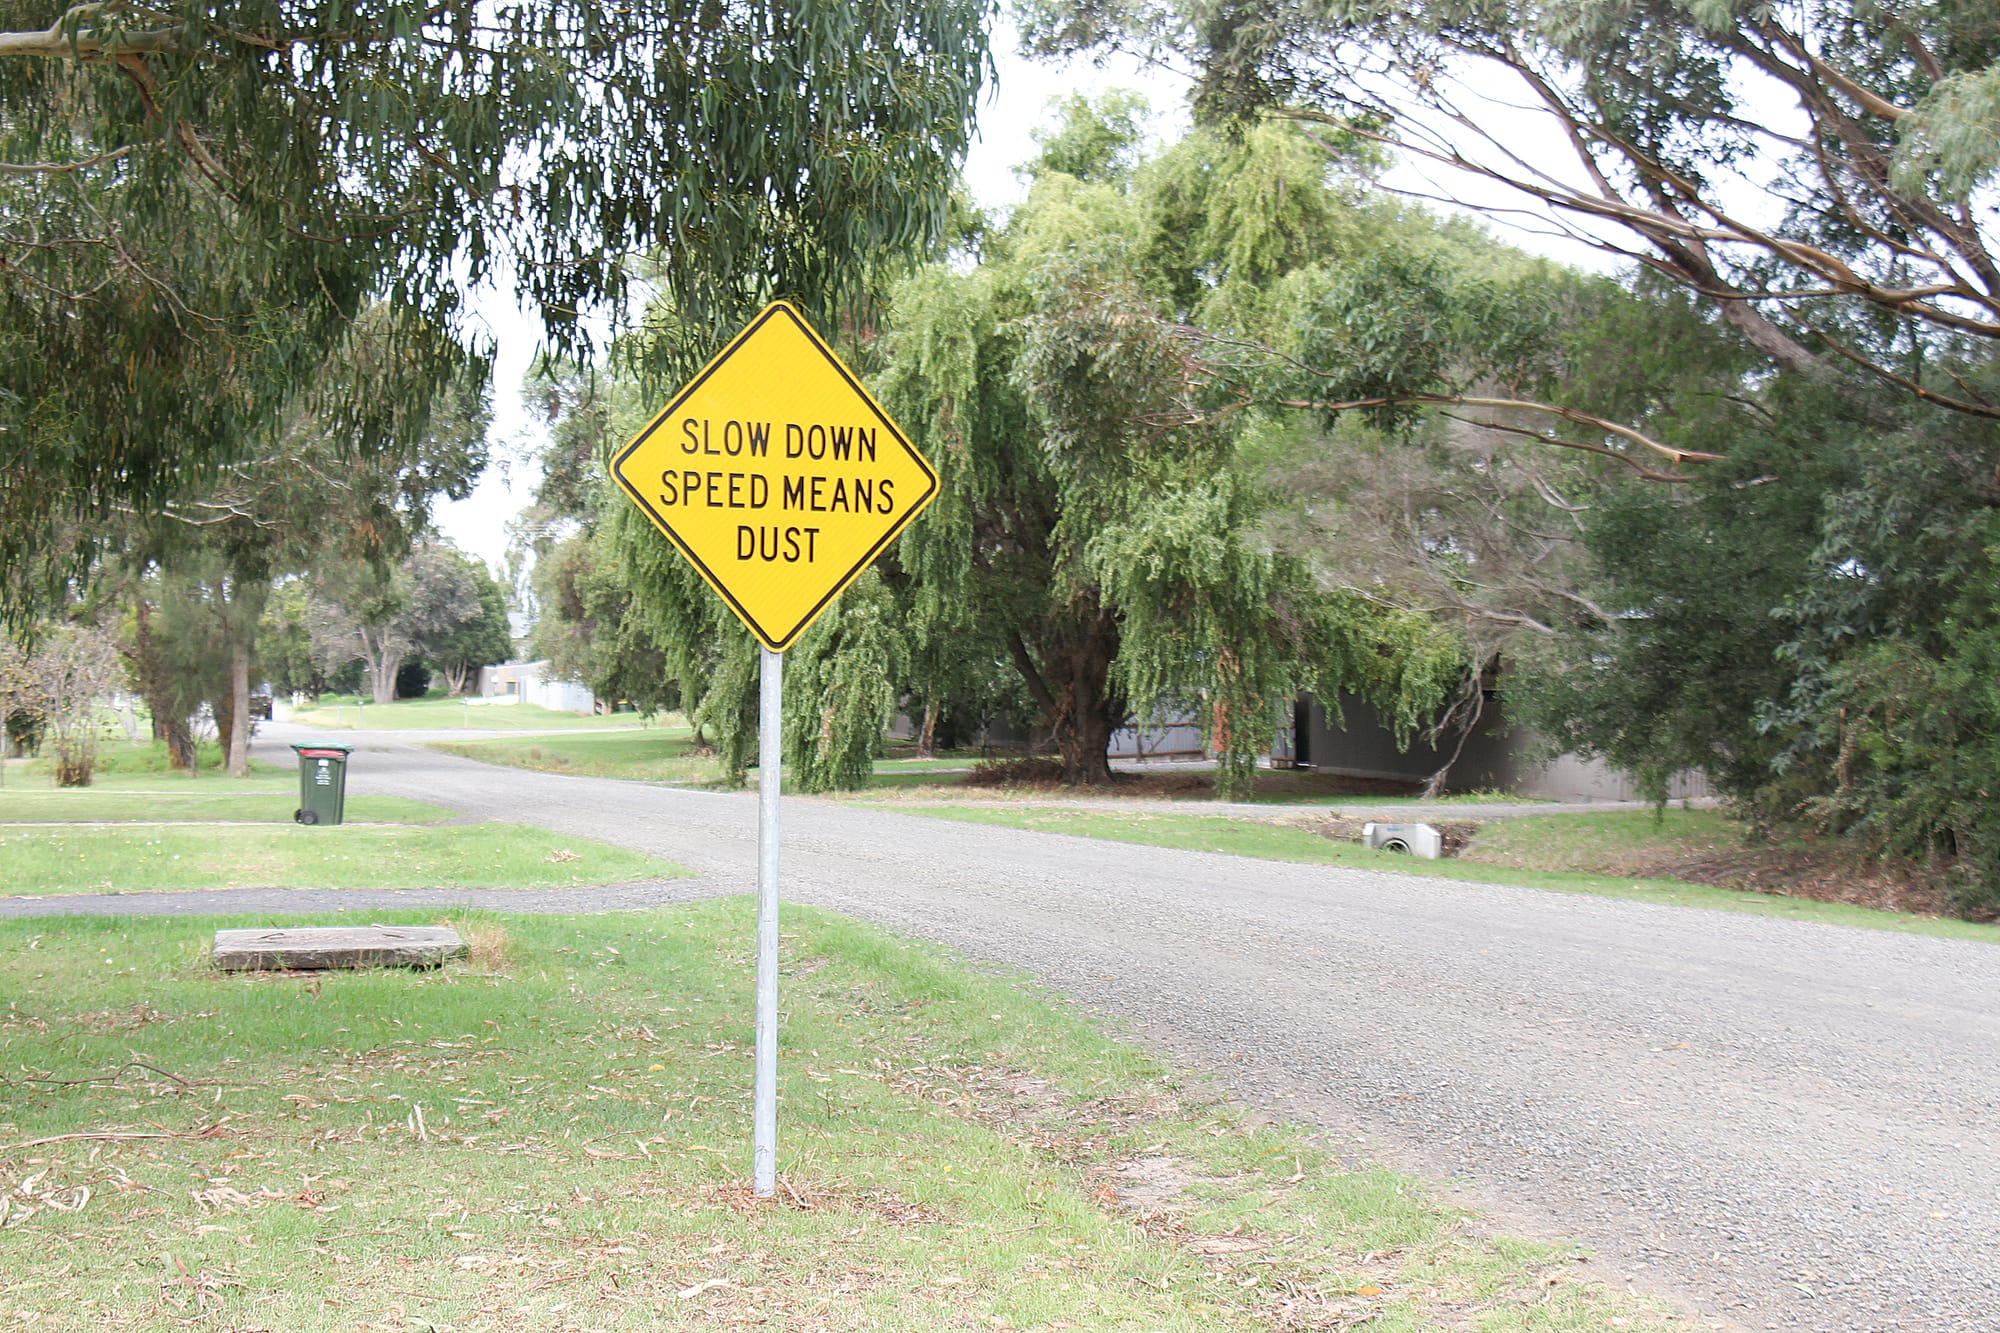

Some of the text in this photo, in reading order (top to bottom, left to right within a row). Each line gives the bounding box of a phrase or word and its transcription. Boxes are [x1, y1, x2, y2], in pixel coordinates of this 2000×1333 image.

[681, 418, 877, 463] SLOW DOWN
[660, 469, 895, 515] SPEED MEANS
[737, 525, 820, 563] DUST
